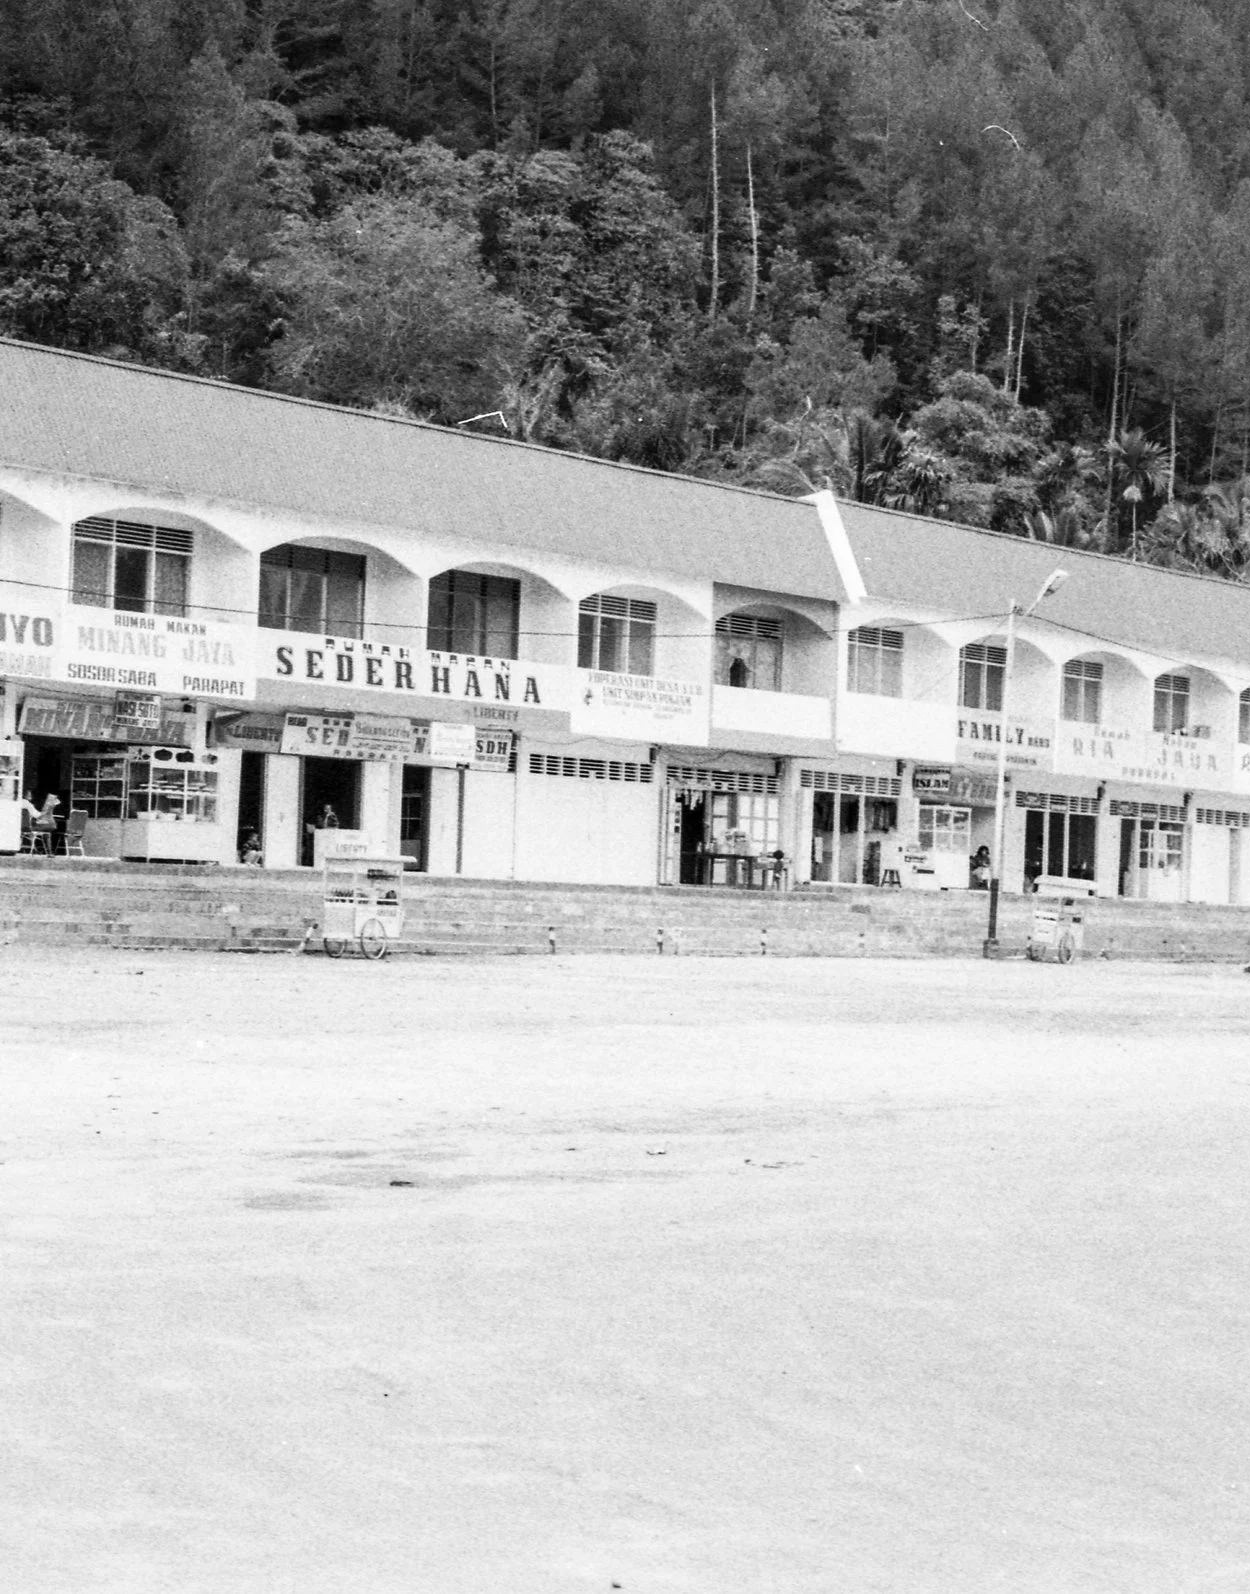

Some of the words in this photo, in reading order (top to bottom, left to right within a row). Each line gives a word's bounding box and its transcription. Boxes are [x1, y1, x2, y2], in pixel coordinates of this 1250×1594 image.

[114, 614, 155, 631] RUMAH
[166, 621, 207, 636] MAKAN
[77, 626, 167, 658] MINANG
[325, 638, 410, 659] RUMAH
[275, 645, 542, 704] SEDERHANA
